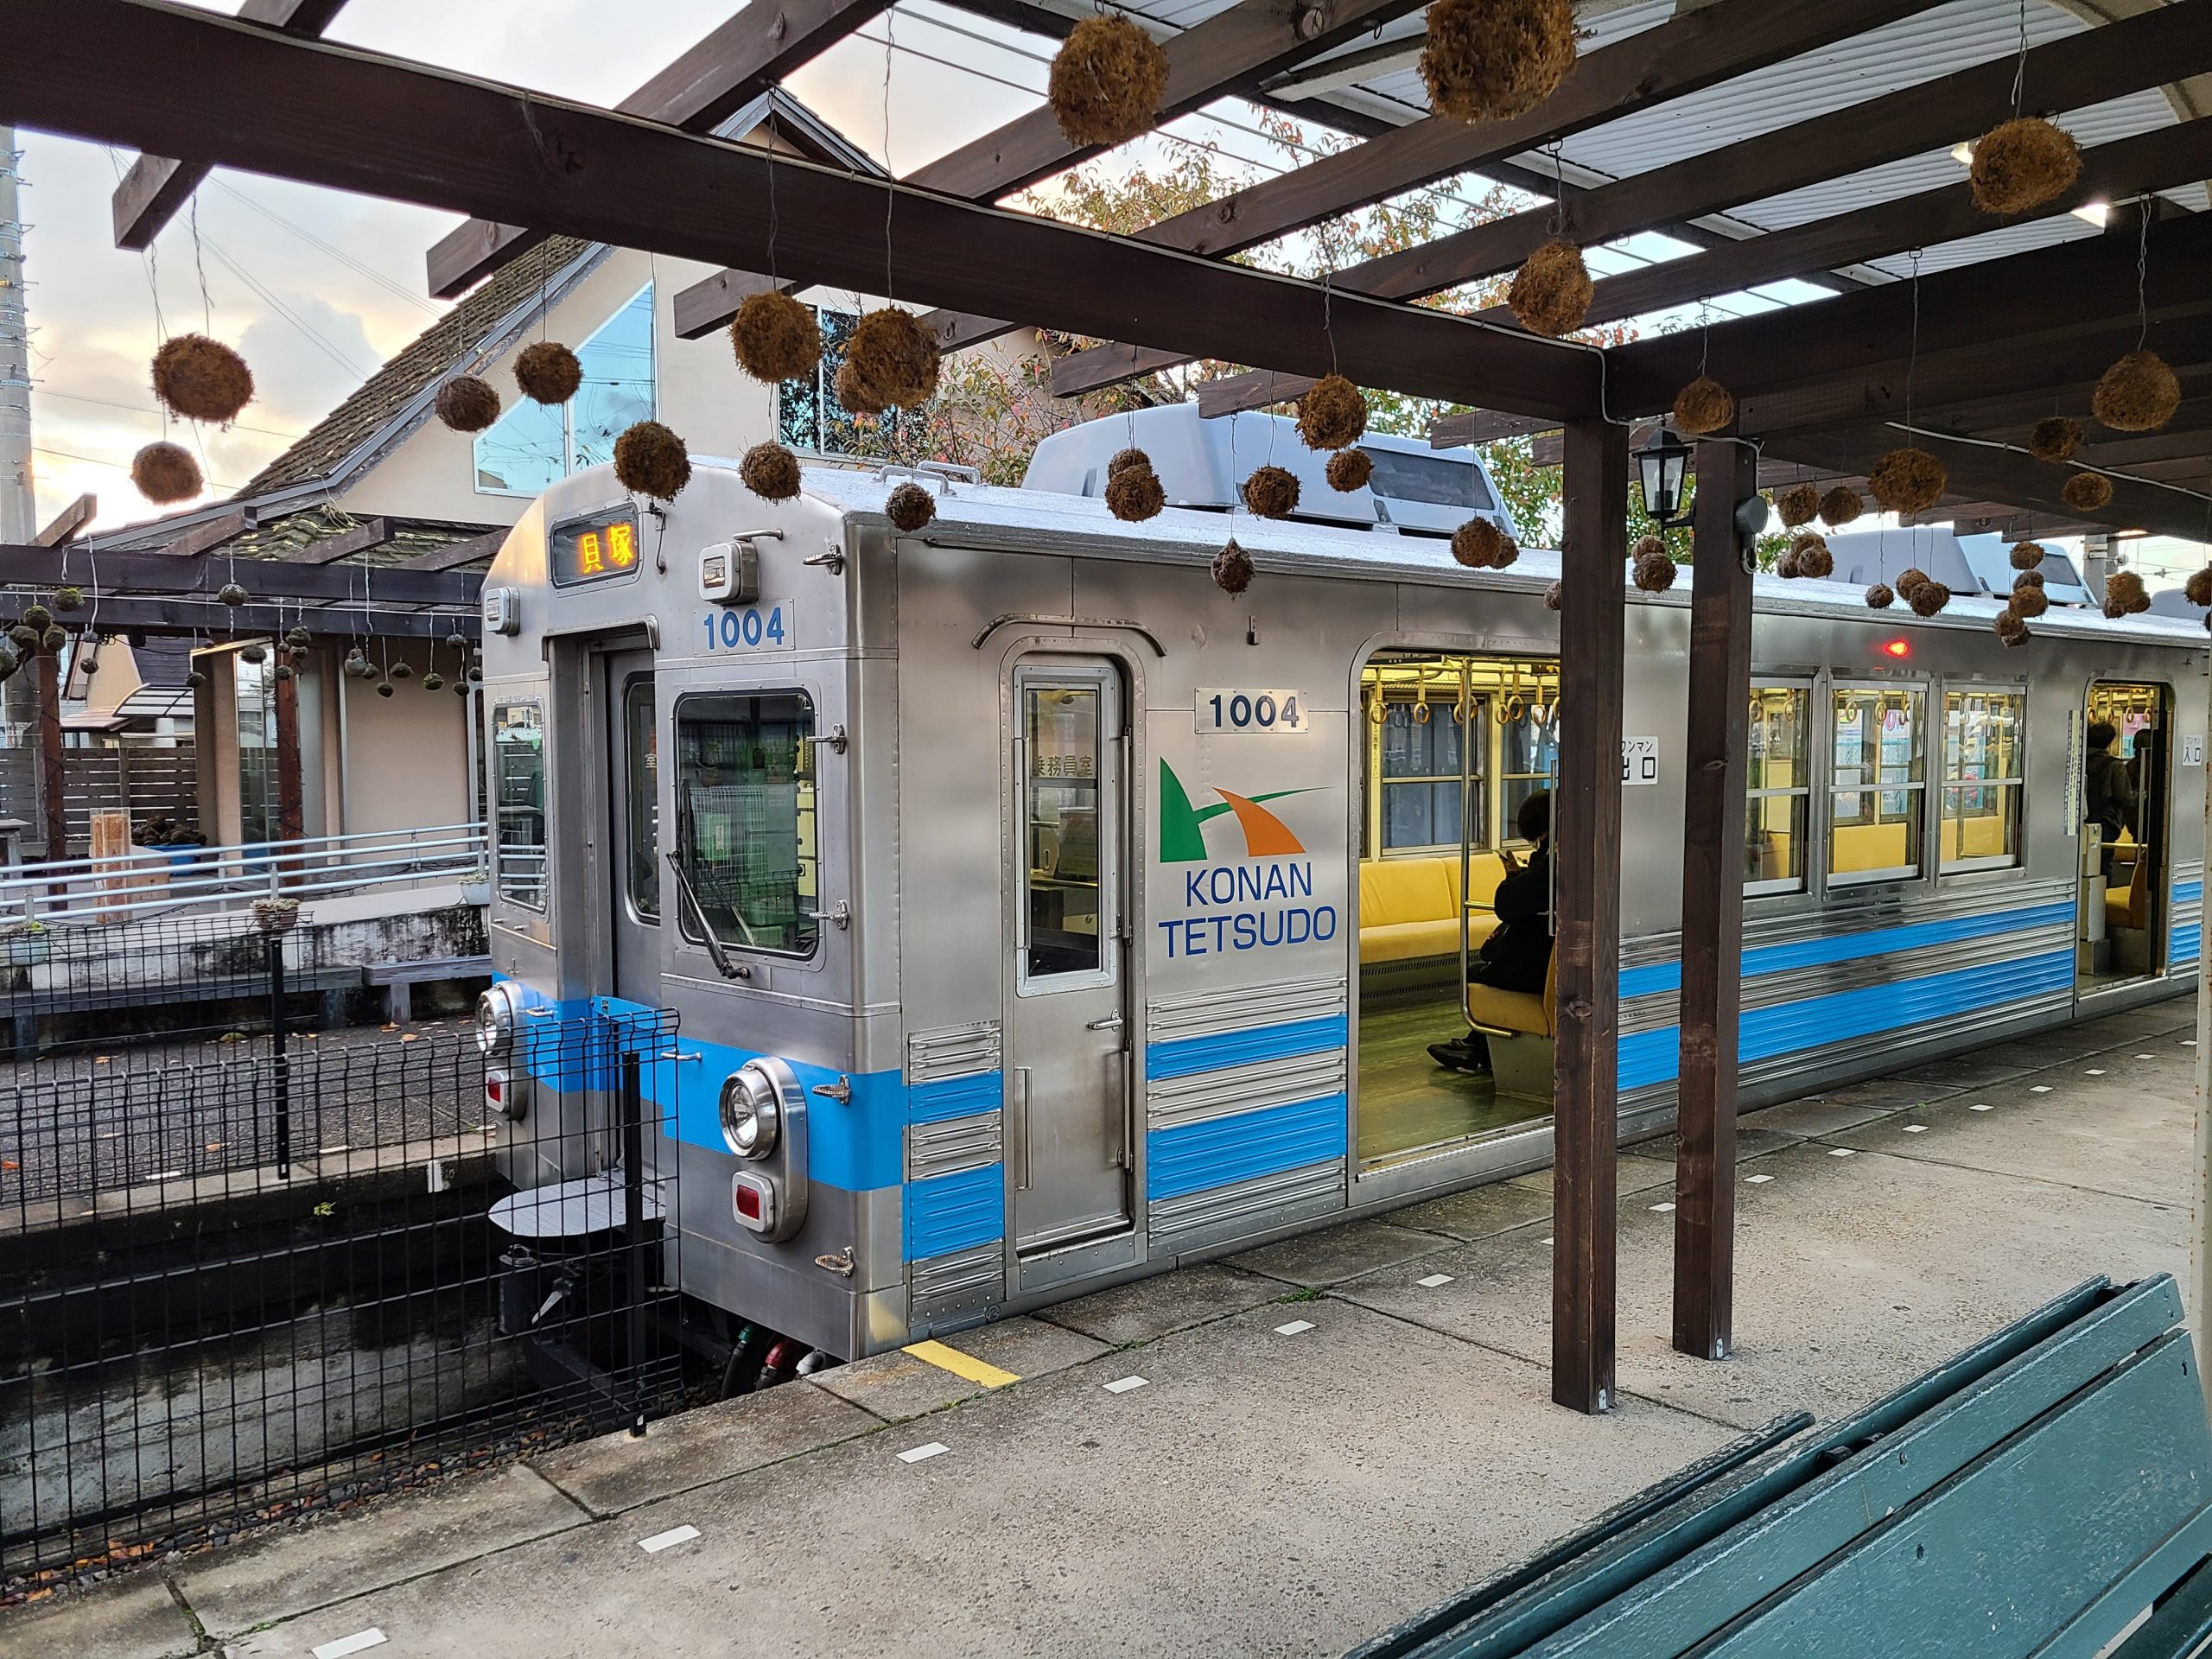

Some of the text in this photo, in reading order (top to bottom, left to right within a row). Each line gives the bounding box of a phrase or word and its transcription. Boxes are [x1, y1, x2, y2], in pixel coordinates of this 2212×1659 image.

[582, 524, 632, 574] 貝塚
[703, 607, 785, 650] 1004
[1210, 694, 1300, 728] 1004
[2183, 747, 2202, 762] 入口
[1186, 862, 1312, 907] KONAN
[1159, 906, 1337, 958] TETSUDO
